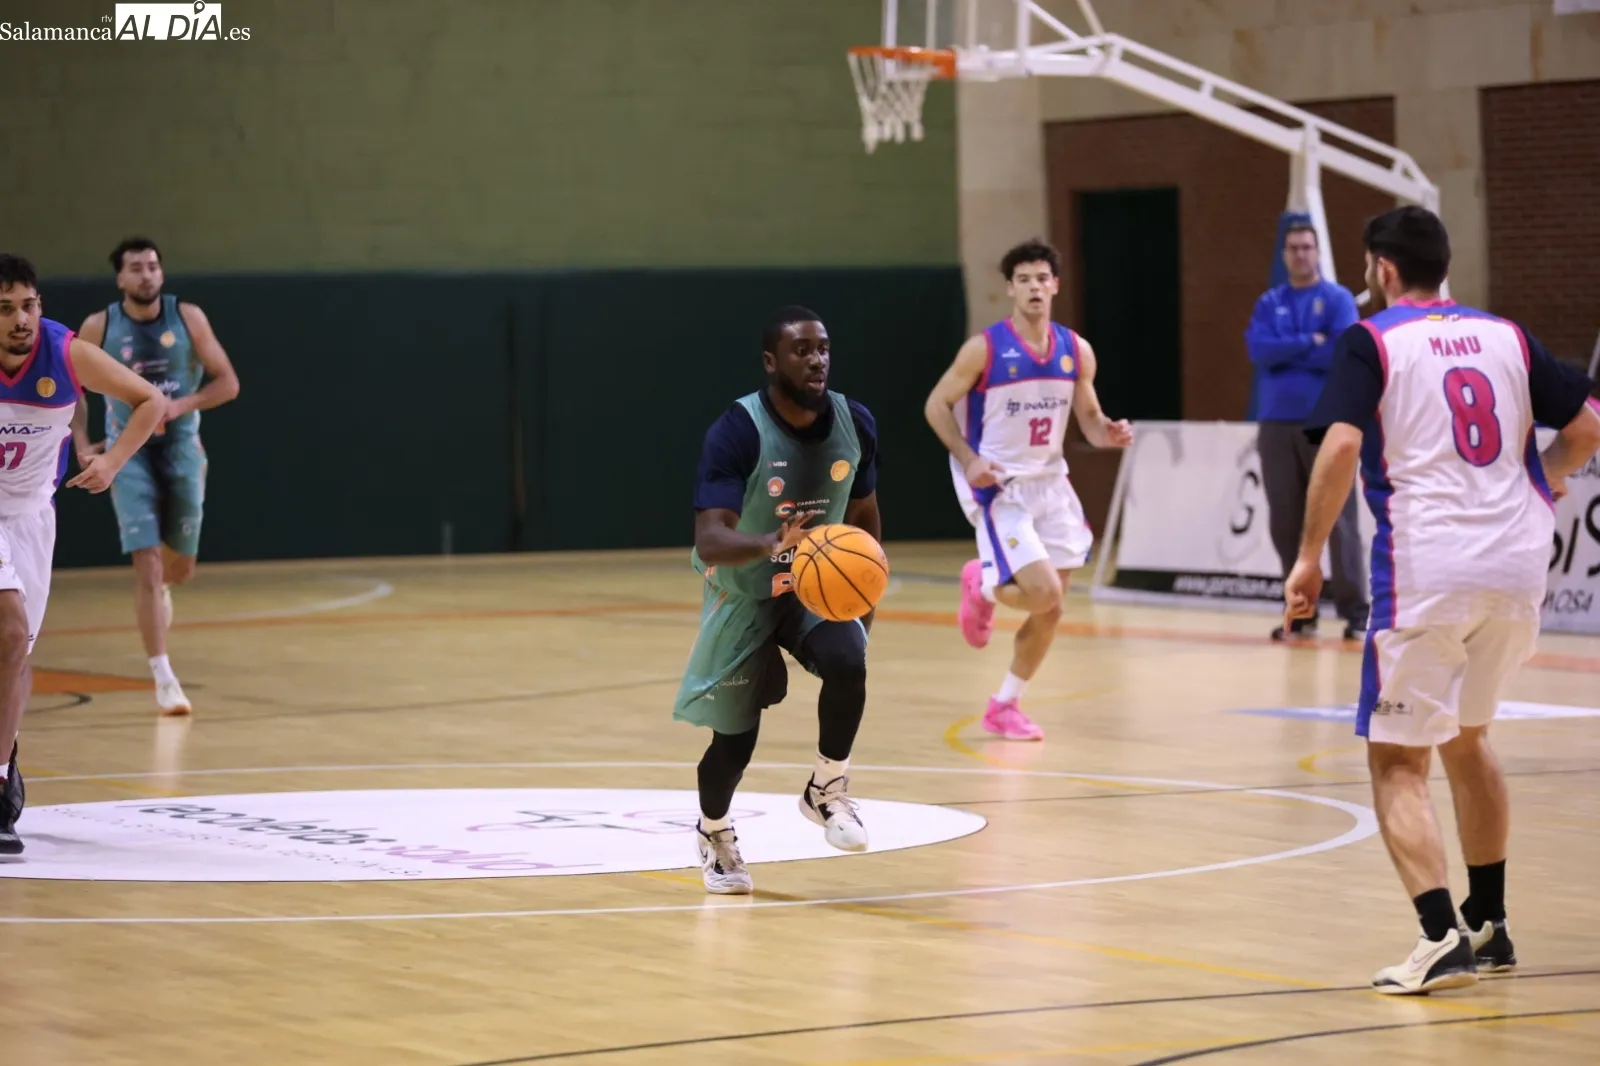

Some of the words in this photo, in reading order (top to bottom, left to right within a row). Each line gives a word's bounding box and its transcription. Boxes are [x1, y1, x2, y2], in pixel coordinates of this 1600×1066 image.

[1428, 335, 1482, 357] MANU
[1443, 366, 1502, 467] 8
[1029, 417, 1052, 446] 12
[0, 441, 27, 471] 7
